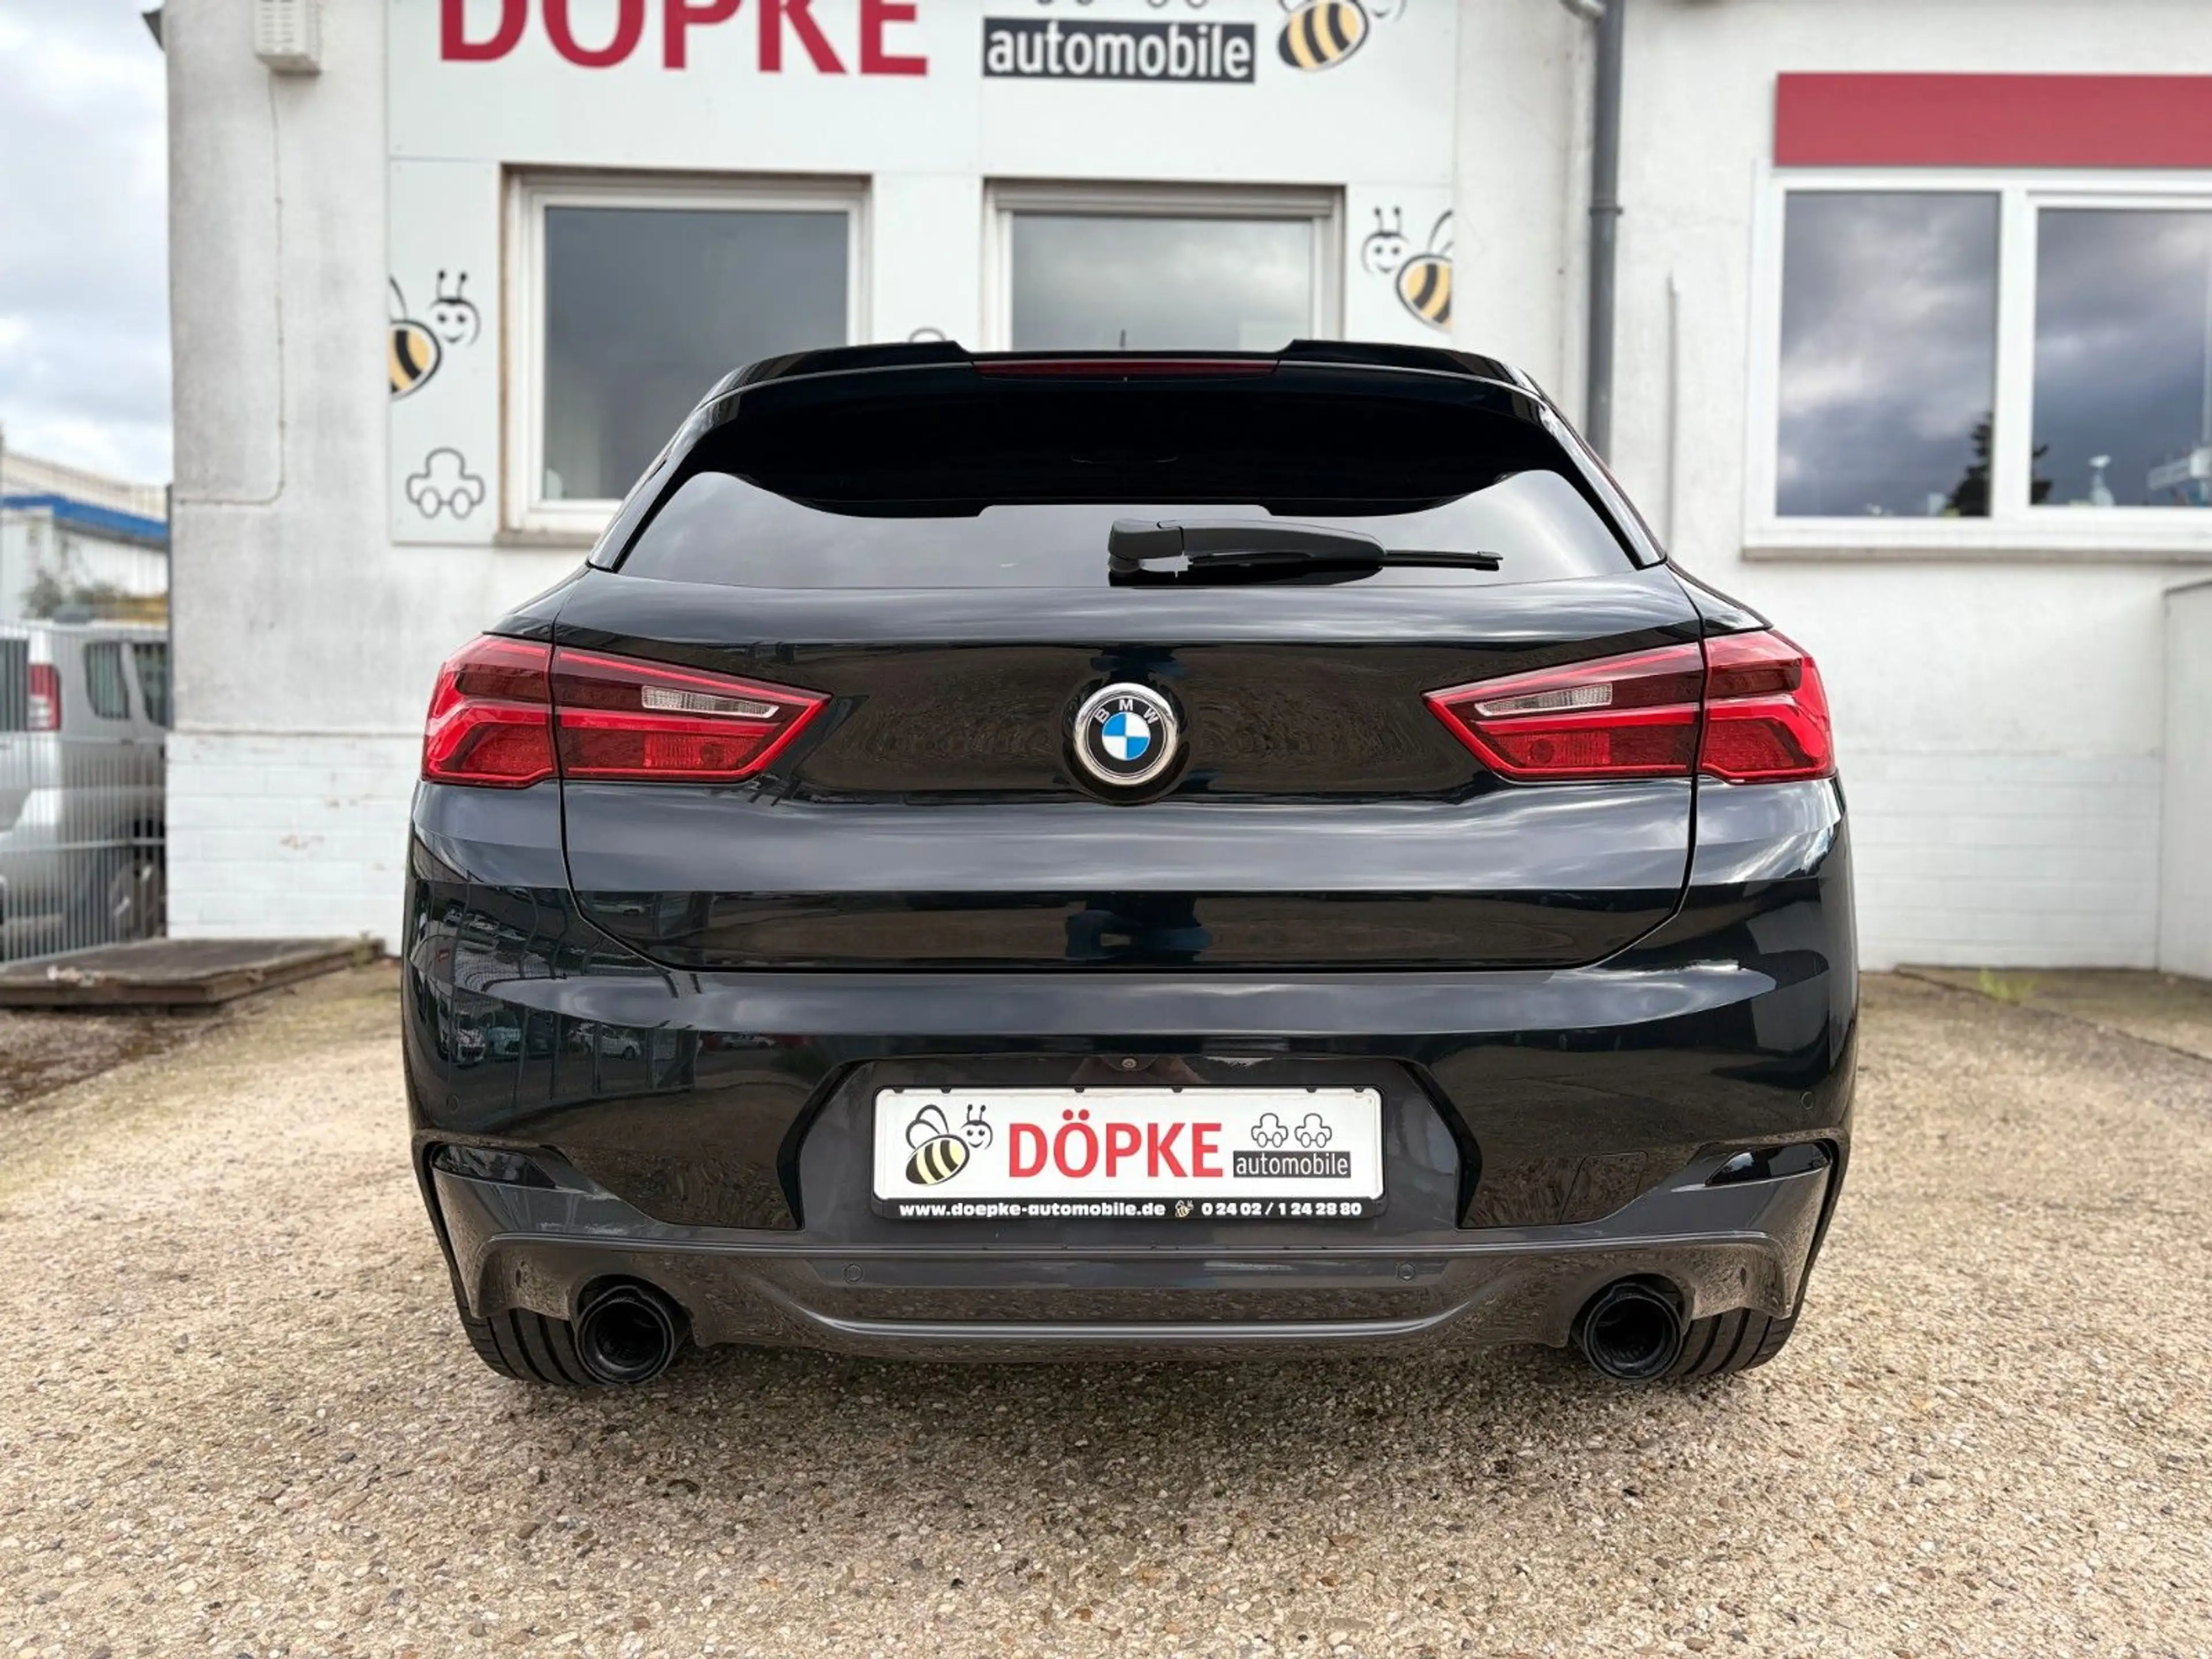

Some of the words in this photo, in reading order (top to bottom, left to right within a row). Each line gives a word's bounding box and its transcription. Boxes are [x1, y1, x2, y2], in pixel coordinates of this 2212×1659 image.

[987, 19, 1251, 78] automobile
[1094, 699, 1160, 724] BMW
[1009, 1109, 1224, 1178] DÖPKE
[1236, 1153, 1349, 1176] automobile
[899, 1202, 1166, 1217] www.doepke-automobile.de
